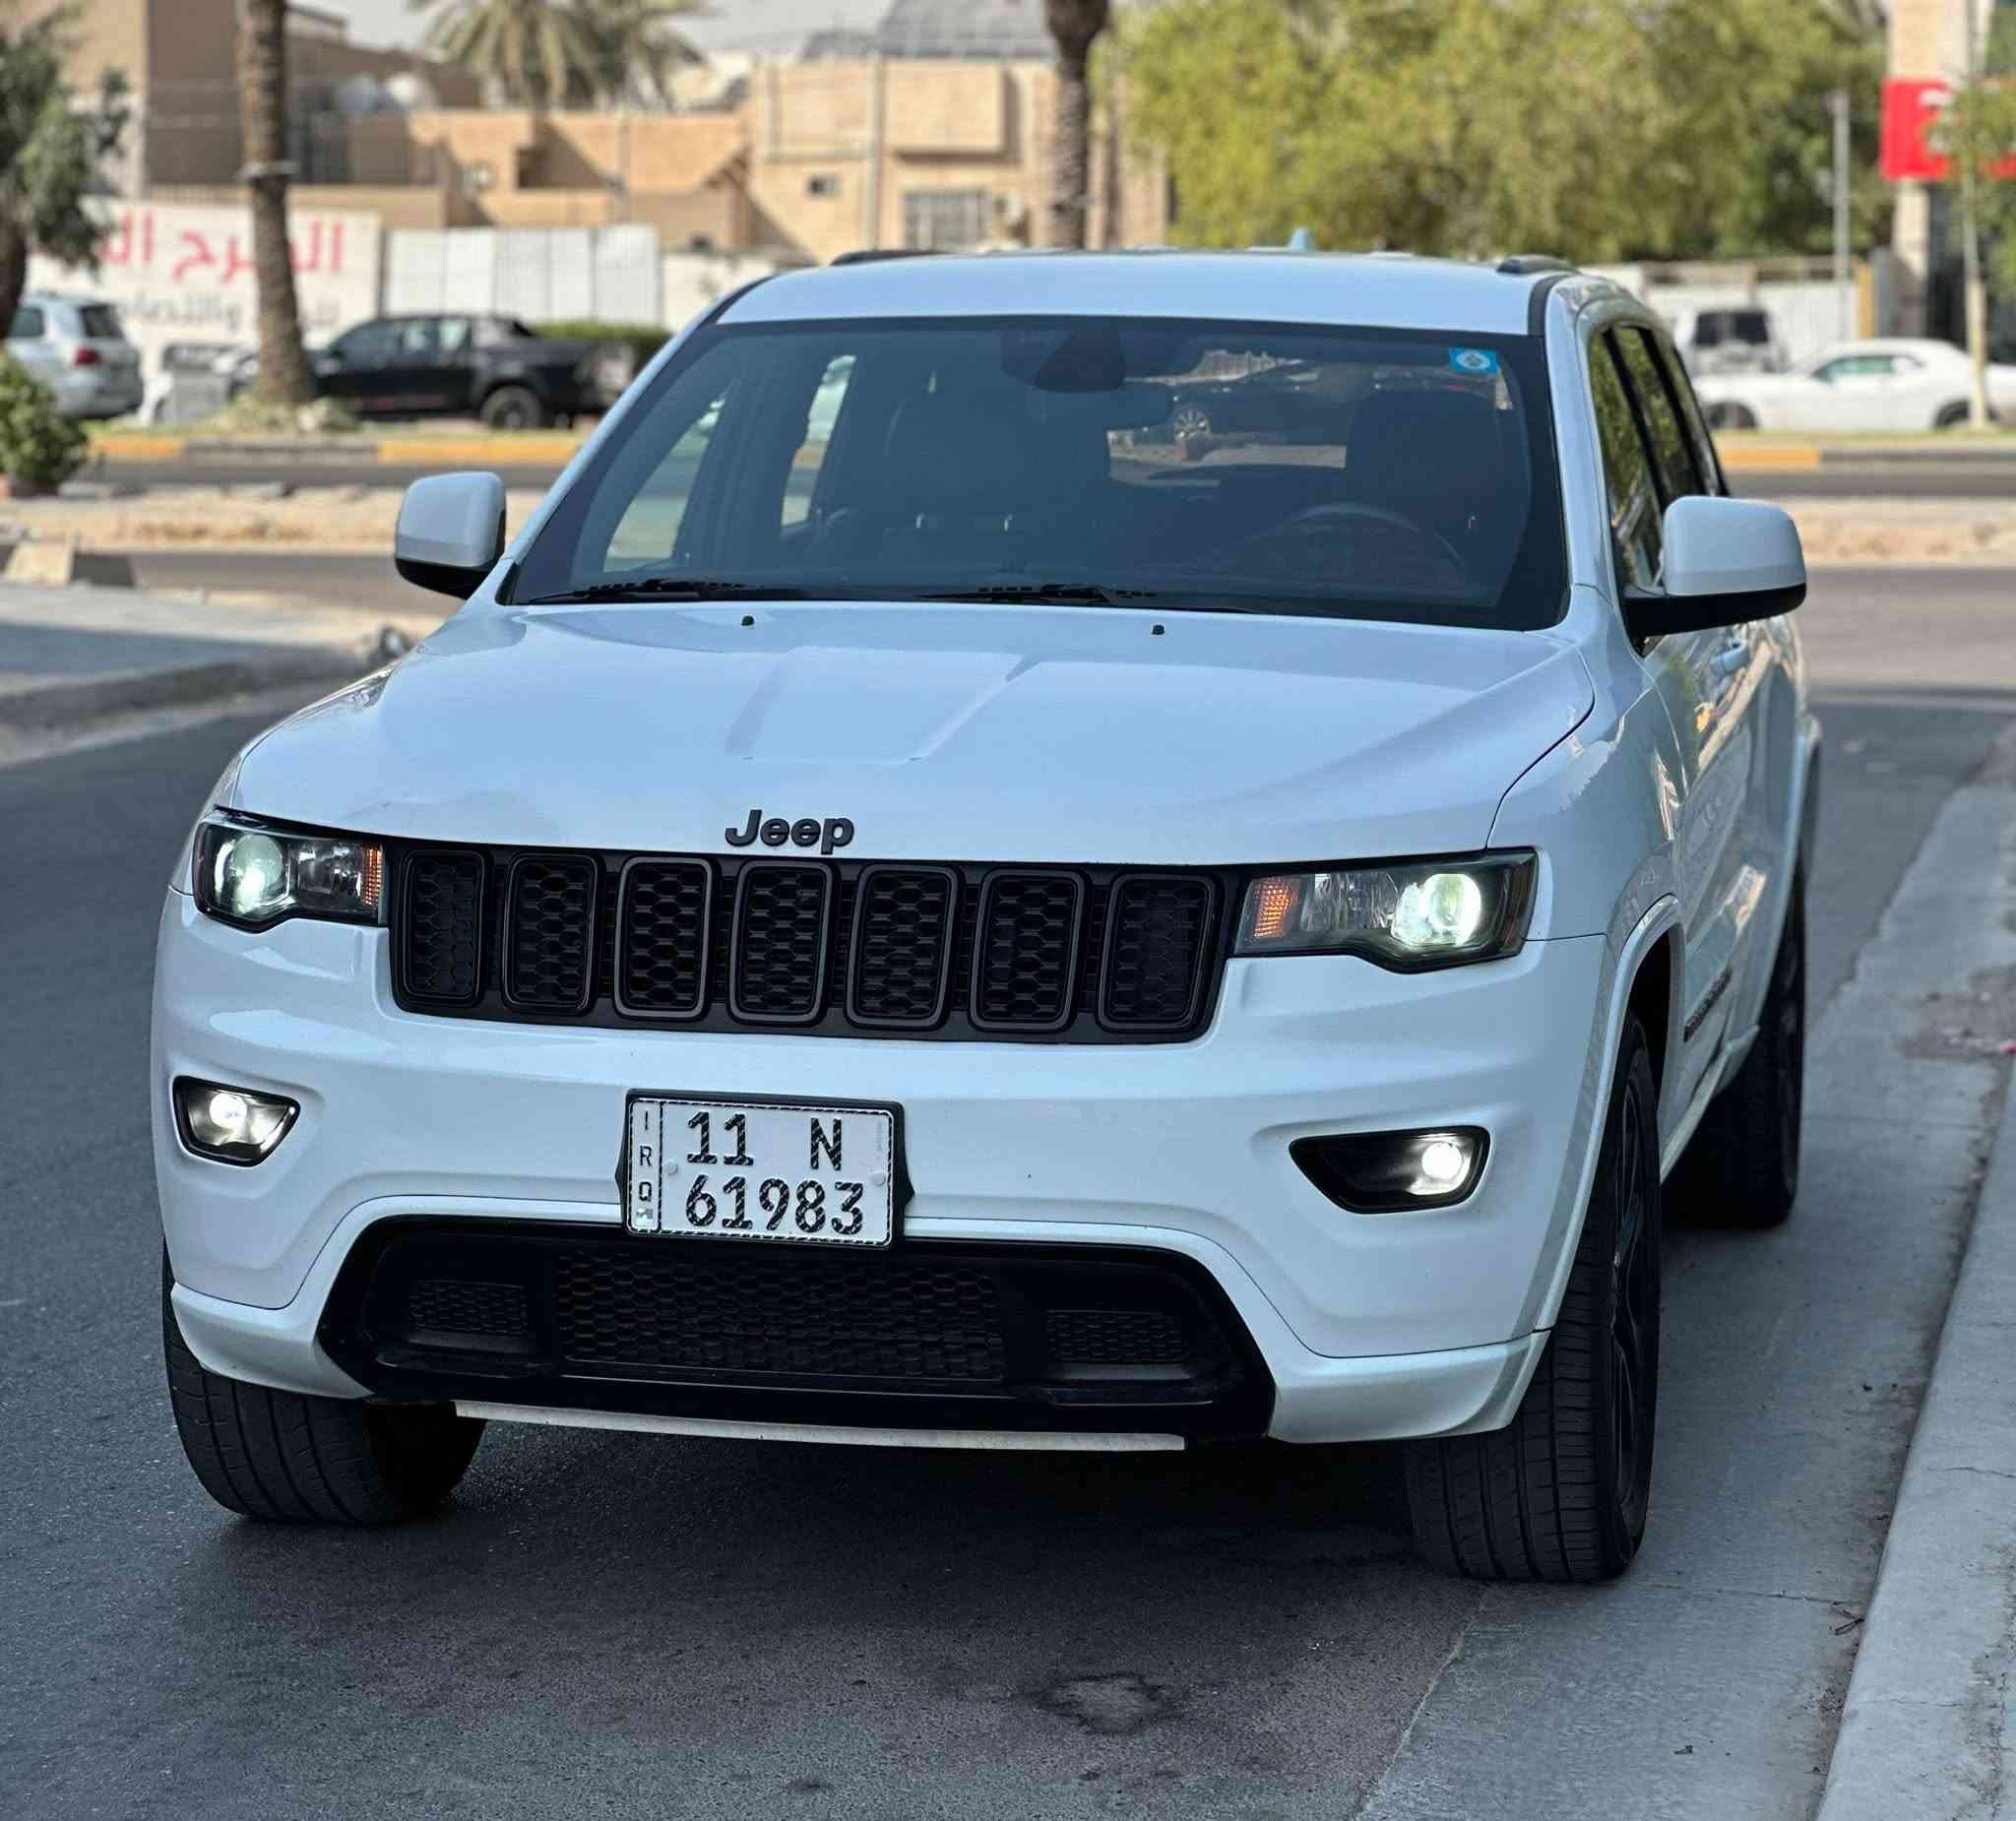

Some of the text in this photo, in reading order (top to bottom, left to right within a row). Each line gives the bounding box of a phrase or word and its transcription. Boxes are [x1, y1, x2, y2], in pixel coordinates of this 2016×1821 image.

[724, 809, 854, 855] Jeep
[687, 1110, 843, 1171] 11 N
[685, 1173, 864, 1235] 61983
